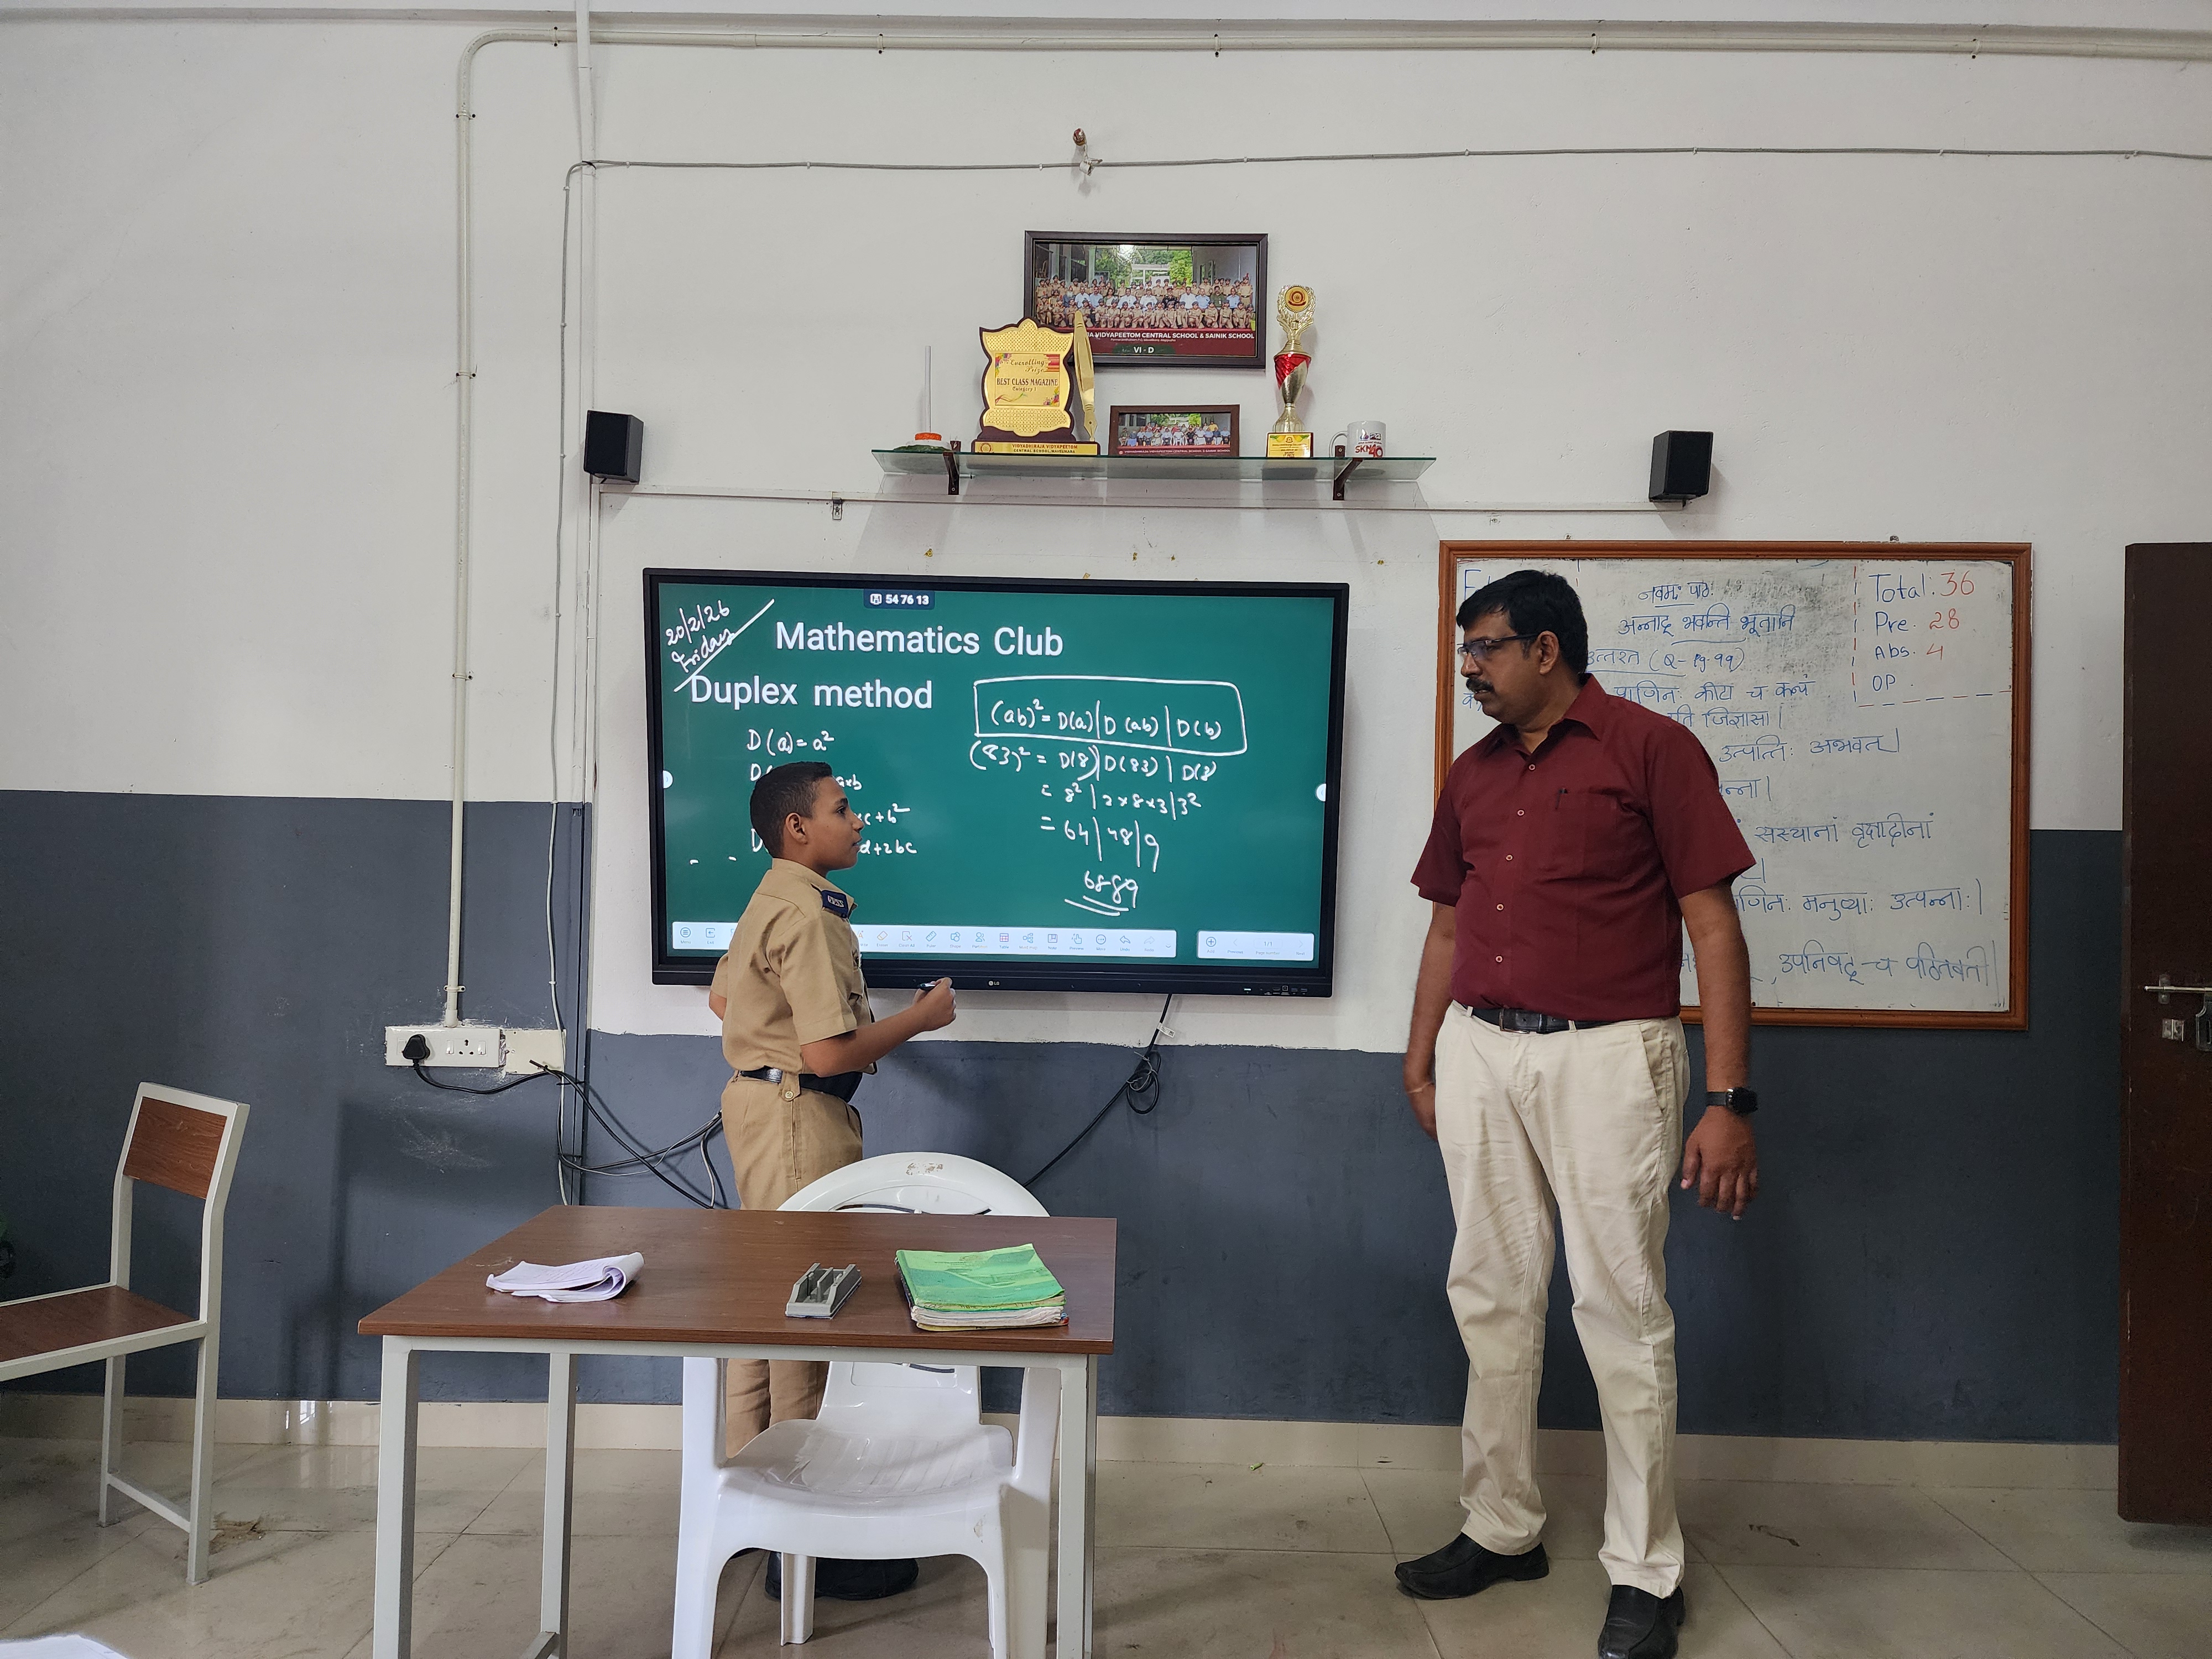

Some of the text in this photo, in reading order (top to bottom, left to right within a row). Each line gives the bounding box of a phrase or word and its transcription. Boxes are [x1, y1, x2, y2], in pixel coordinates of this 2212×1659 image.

[1940, 570, 1975, 597] 36
[886, 594, 929, 605] 54 76 13
[666, 599, 730, 646] 20/2/26
[1929, 608, 1961, 631] 28
[776, 622, 1063, 656] Mathematics Club
[1926, 643, 1944, 661] 4
[691, 675, 932, 710] Duplex method
[1746, 685, 1768, 701] च
